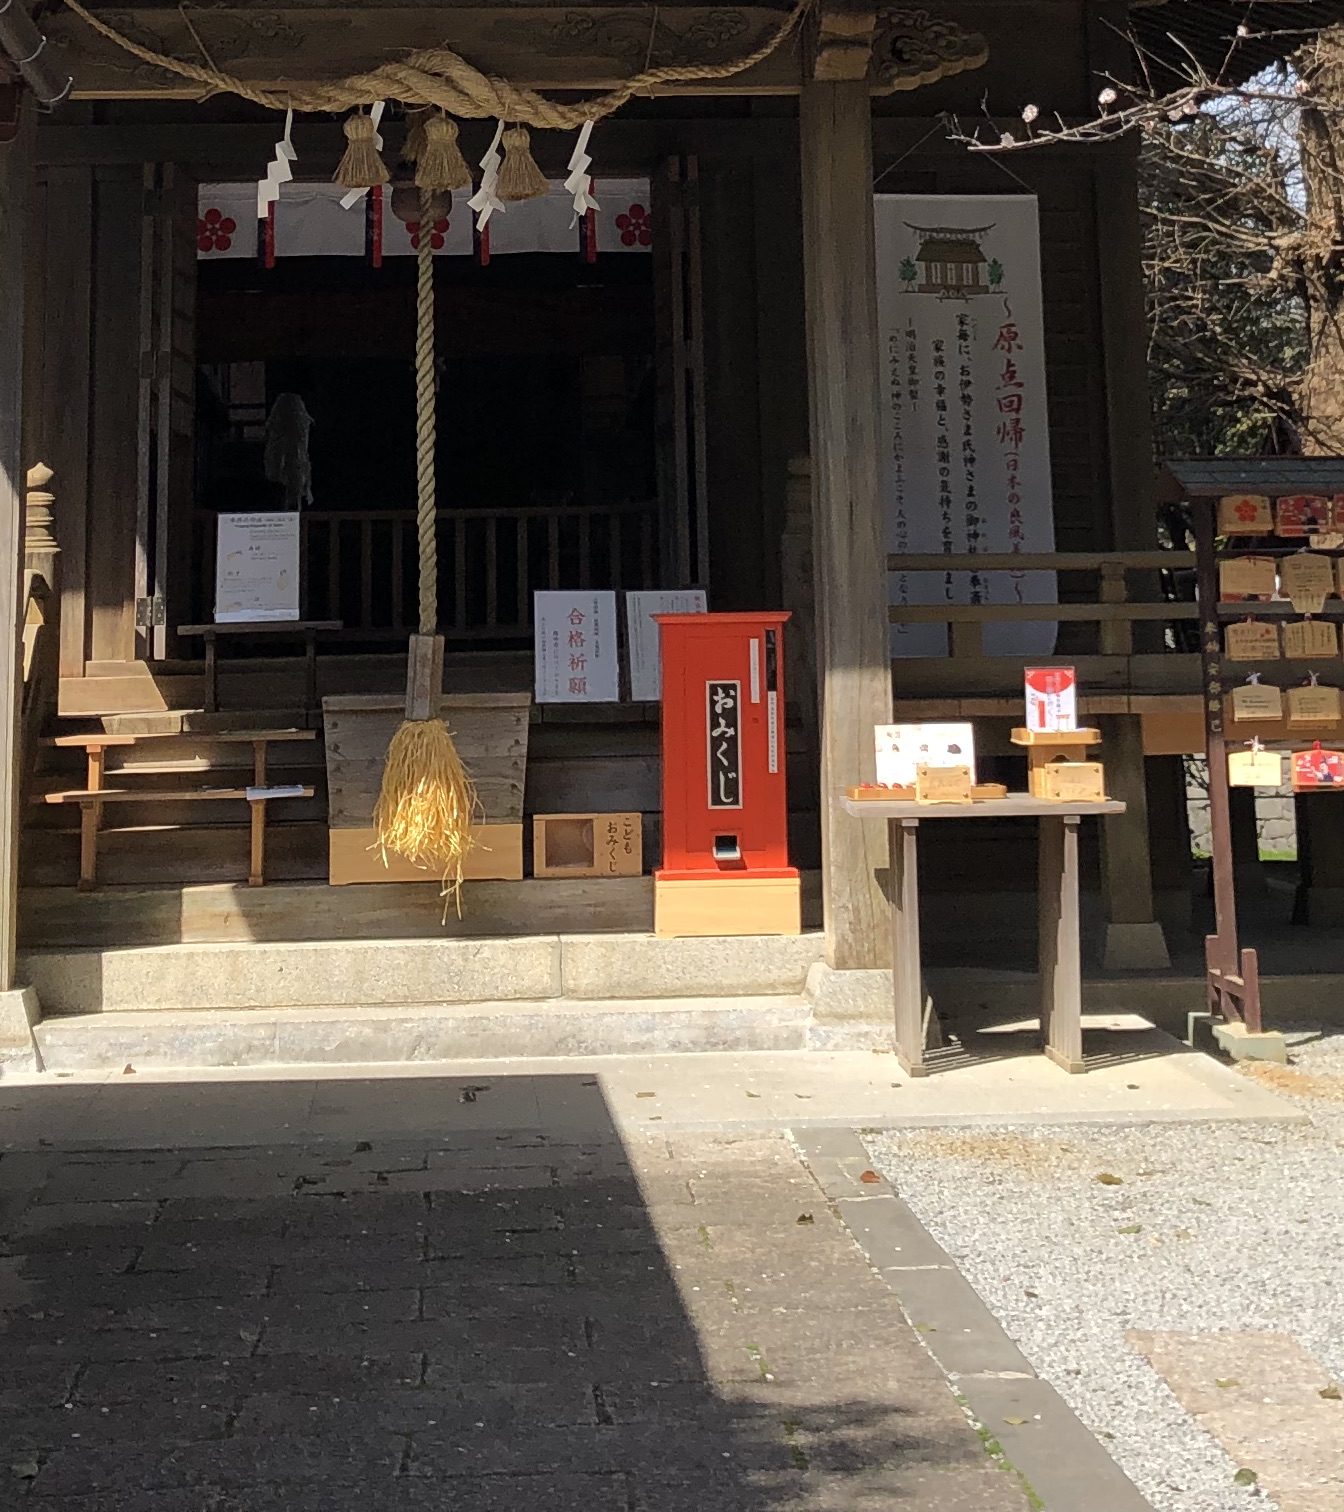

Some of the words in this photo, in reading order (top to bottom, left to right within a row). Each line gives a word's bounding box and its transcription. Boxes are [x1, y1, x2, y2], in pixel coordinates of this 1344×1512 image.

[567, 607, 588, 695] 合格祈願
[711, 686, 737, 803] おみくじ
[605, 821, 619, 872] おみくじ
[623, 817, 634, 854] こども
